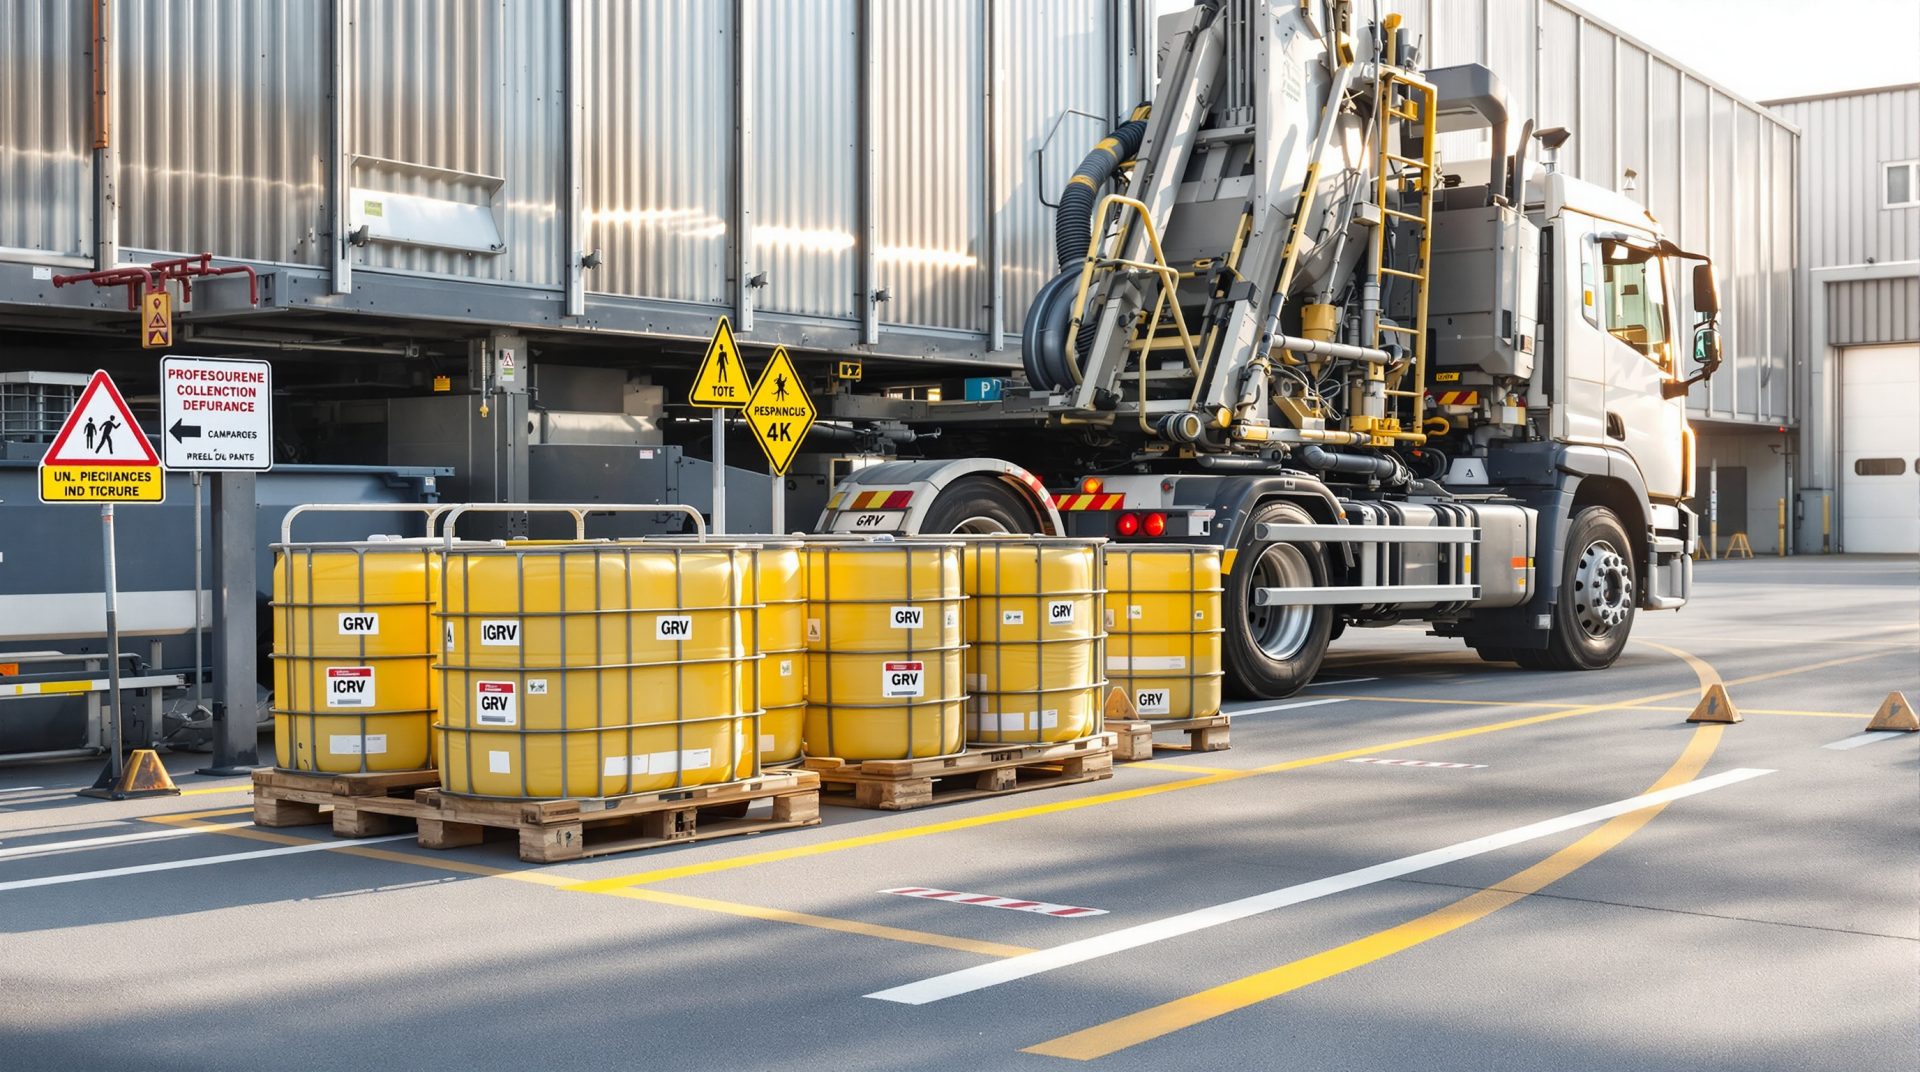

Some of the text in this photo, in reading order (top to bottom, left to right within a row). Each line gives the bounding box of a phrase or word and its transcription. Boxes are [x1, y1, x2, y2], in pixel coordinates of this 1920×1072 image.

[168, 369, 264, 383] PROFESOURENE
[177, 384, 256, 397] COLLENCTION
[712, 385, 735, 397] TOTE
[183, 400, 255, 412] DEFURANCE
[766, 422, 792, 442] 4K
[64, 486, 85, 496] IND
[856, 514, 886, 526] GRV
[343, 616, 374, 631] GRV
[895, 610, 920, 624] GRV
[483, 625, 517, 641] IGRV
[661, 620, 689, 635] GRV
[891, 673, 918, 686] GRV
[333, 680, 366, 693] ICRV
[481, 696, 508, 711] GRV
